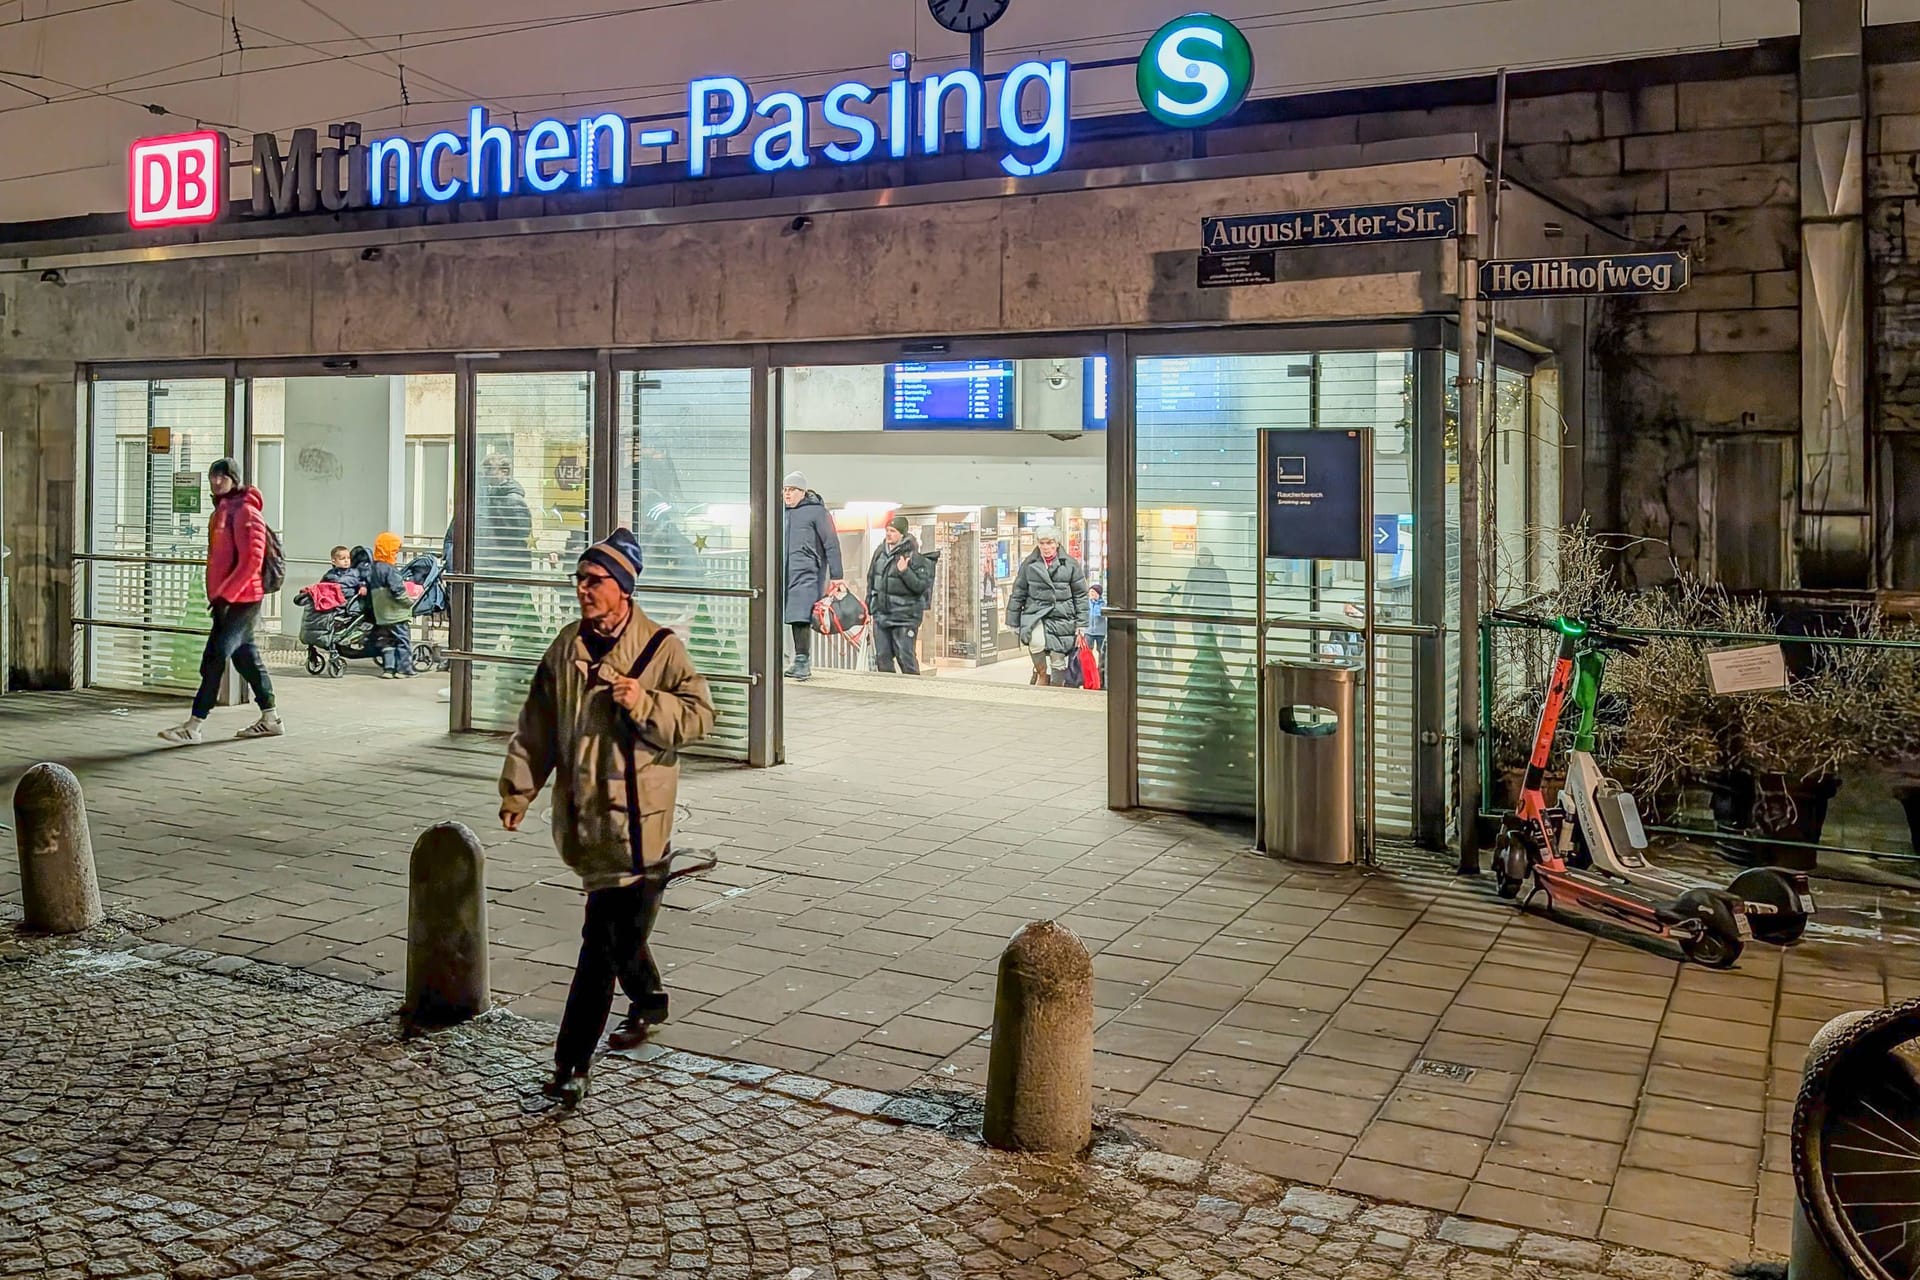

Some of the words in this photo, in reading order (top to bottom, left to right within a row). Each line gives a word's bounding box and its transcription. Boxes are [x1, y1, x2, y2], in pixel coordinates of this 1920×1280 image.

[1156, 26, 1230, 117] S
[251, 50, 1071, 217] München-Pasing
[142, 149, 207, 213] DB
[1210, 206, 1445, 249] August-Exter-Str.
[1491, 259, 1673, 291] Hellihofweg
